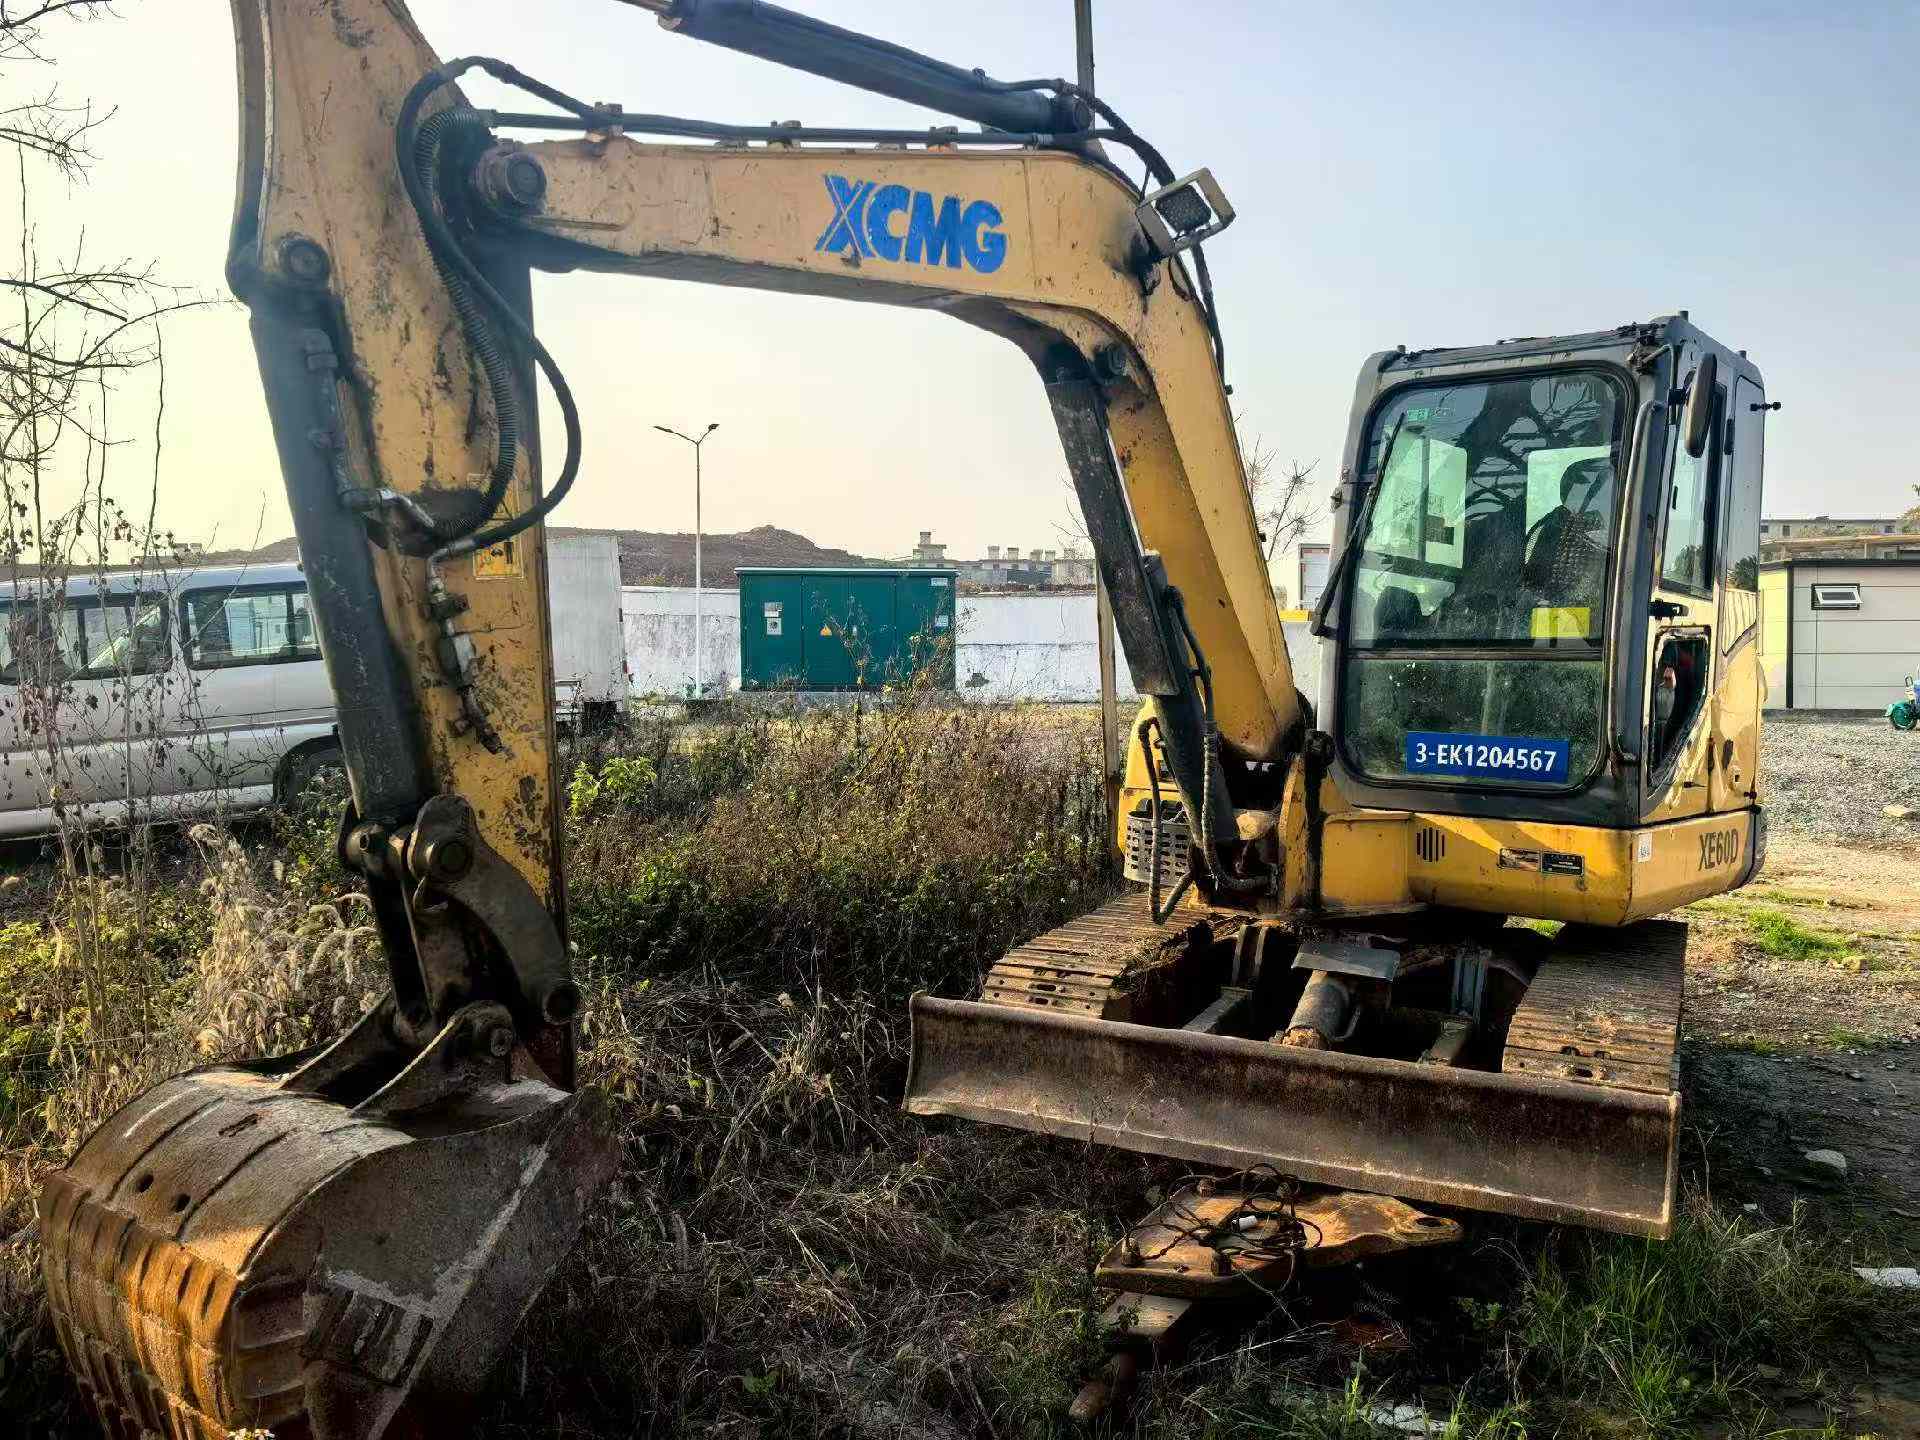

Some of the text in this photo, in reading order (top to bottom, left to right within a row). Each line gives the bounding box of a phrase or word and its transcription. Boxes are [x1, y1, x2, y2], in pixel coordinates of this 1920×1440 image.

[815, 174, 1008, 273] XCMG
[1415, 742, 1556, 772] 3-EK1204567
[1698, 828, 1739, 872] XE60D
